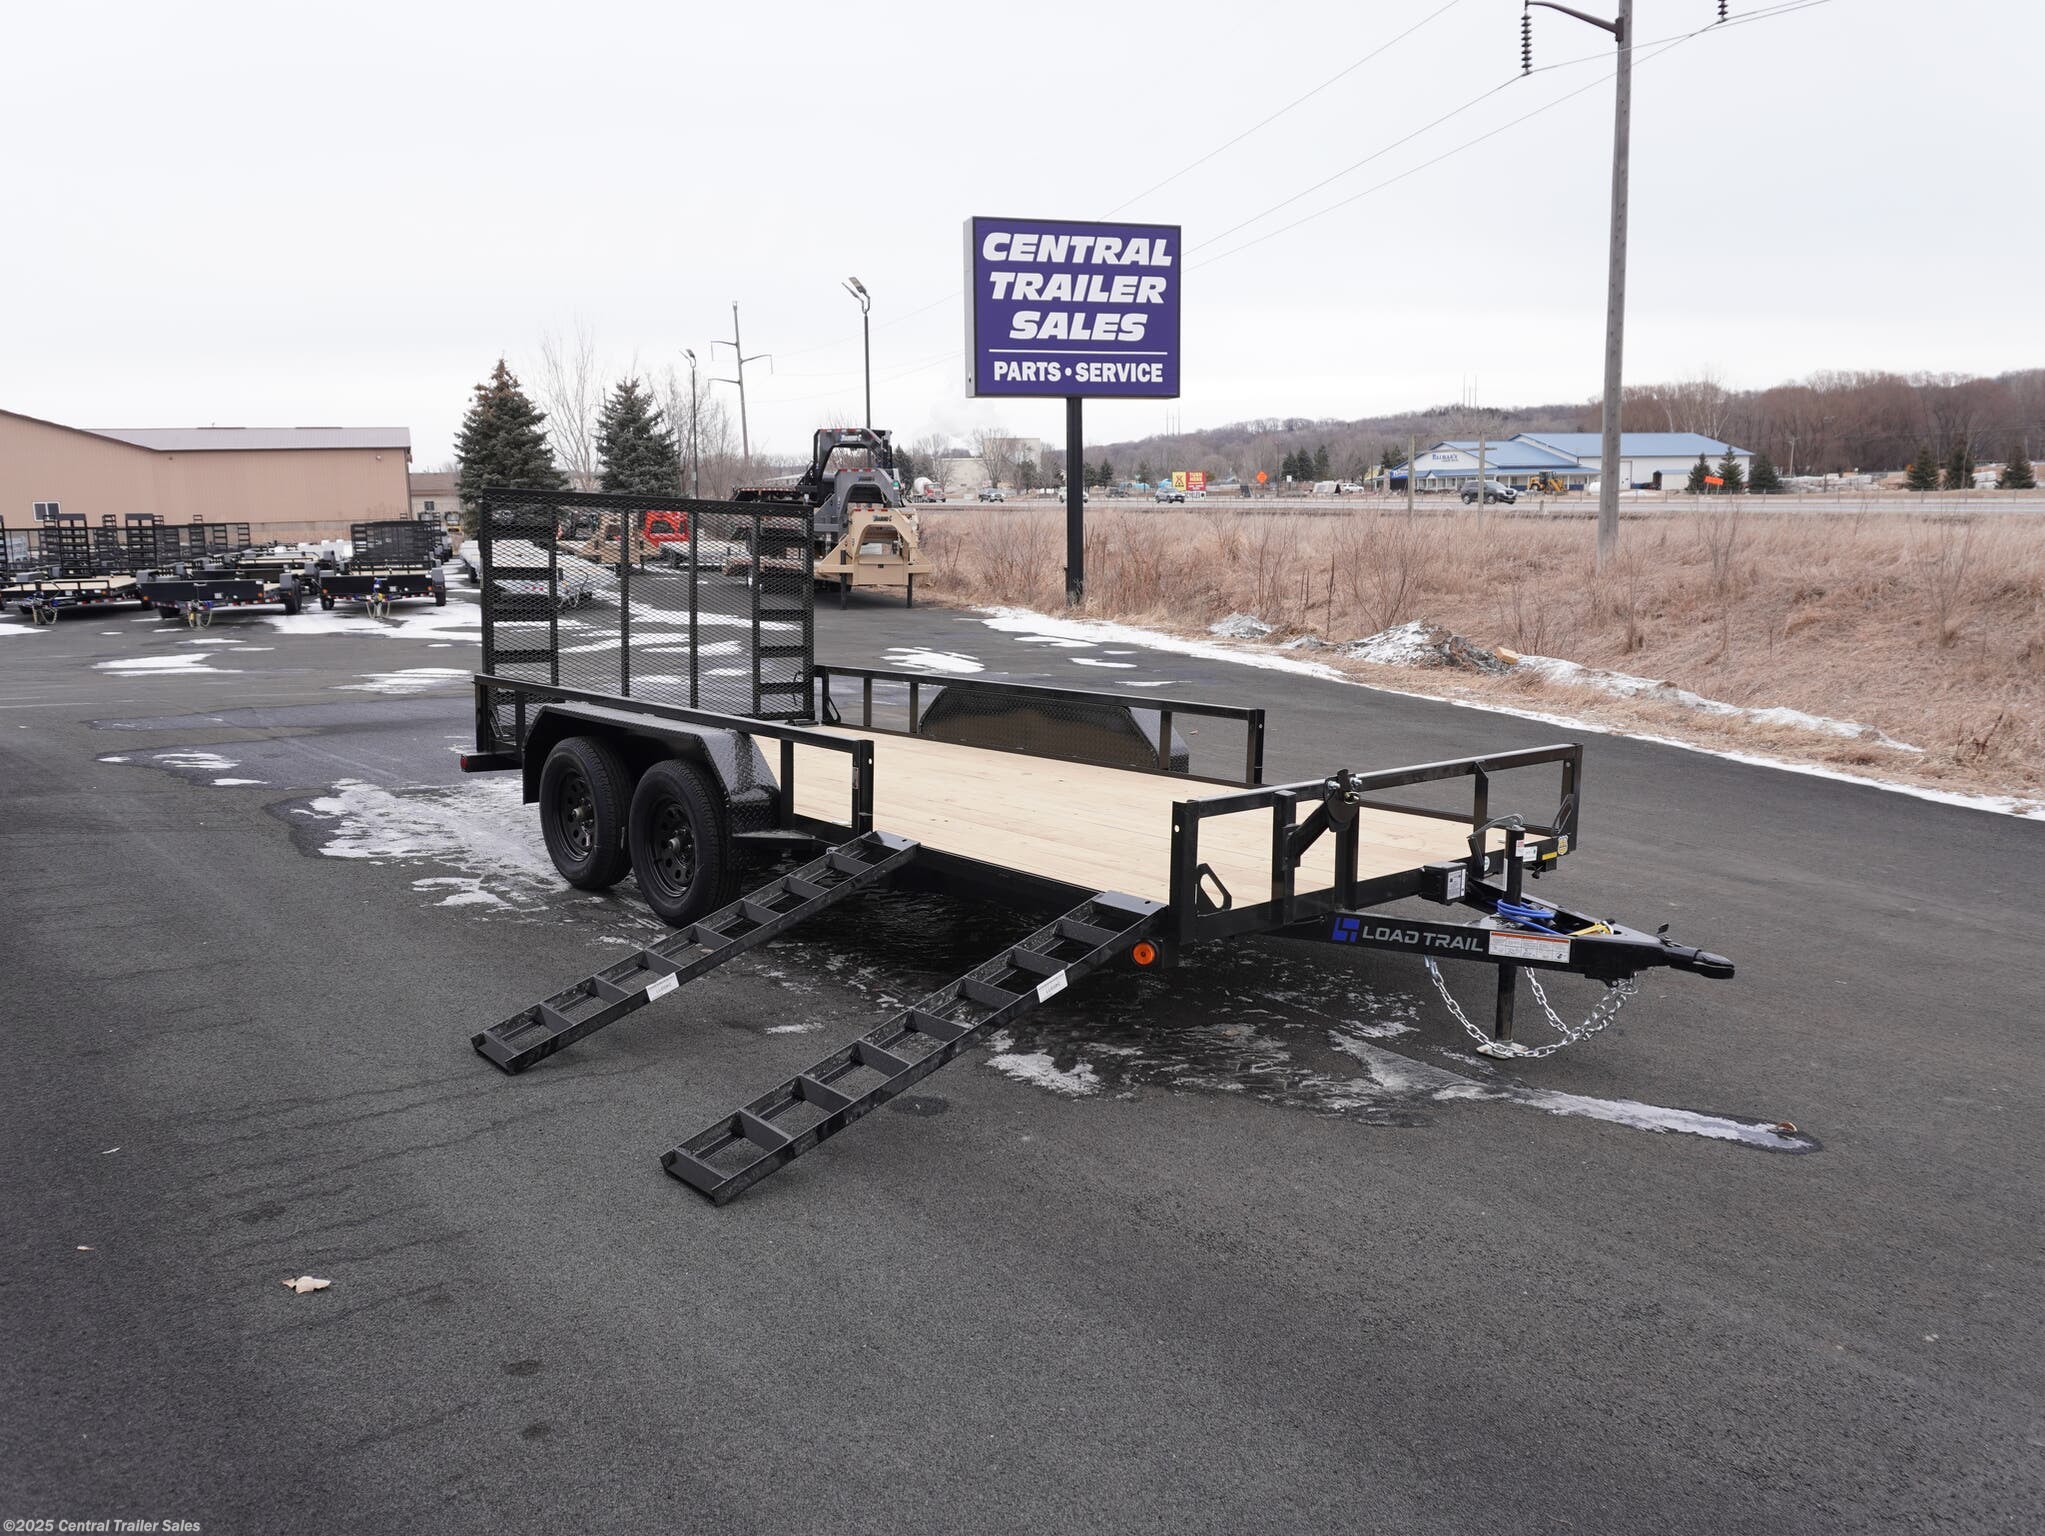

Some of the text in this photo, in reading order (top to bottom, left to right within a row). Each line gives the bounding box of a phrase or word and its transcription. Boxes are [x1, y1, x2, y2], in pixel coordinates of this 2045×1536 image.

[983, 232, 1172, 267] CENTRAL
[989, 271, 1167, 304] TRAILER
[1009, 310, 1148, 342] SALES
[994, 361, 1163, 383] PARTS SERVICE
[1362, 926, 1419, 945] LOAD
[1423, 932, 1484, 952] TRAIL
